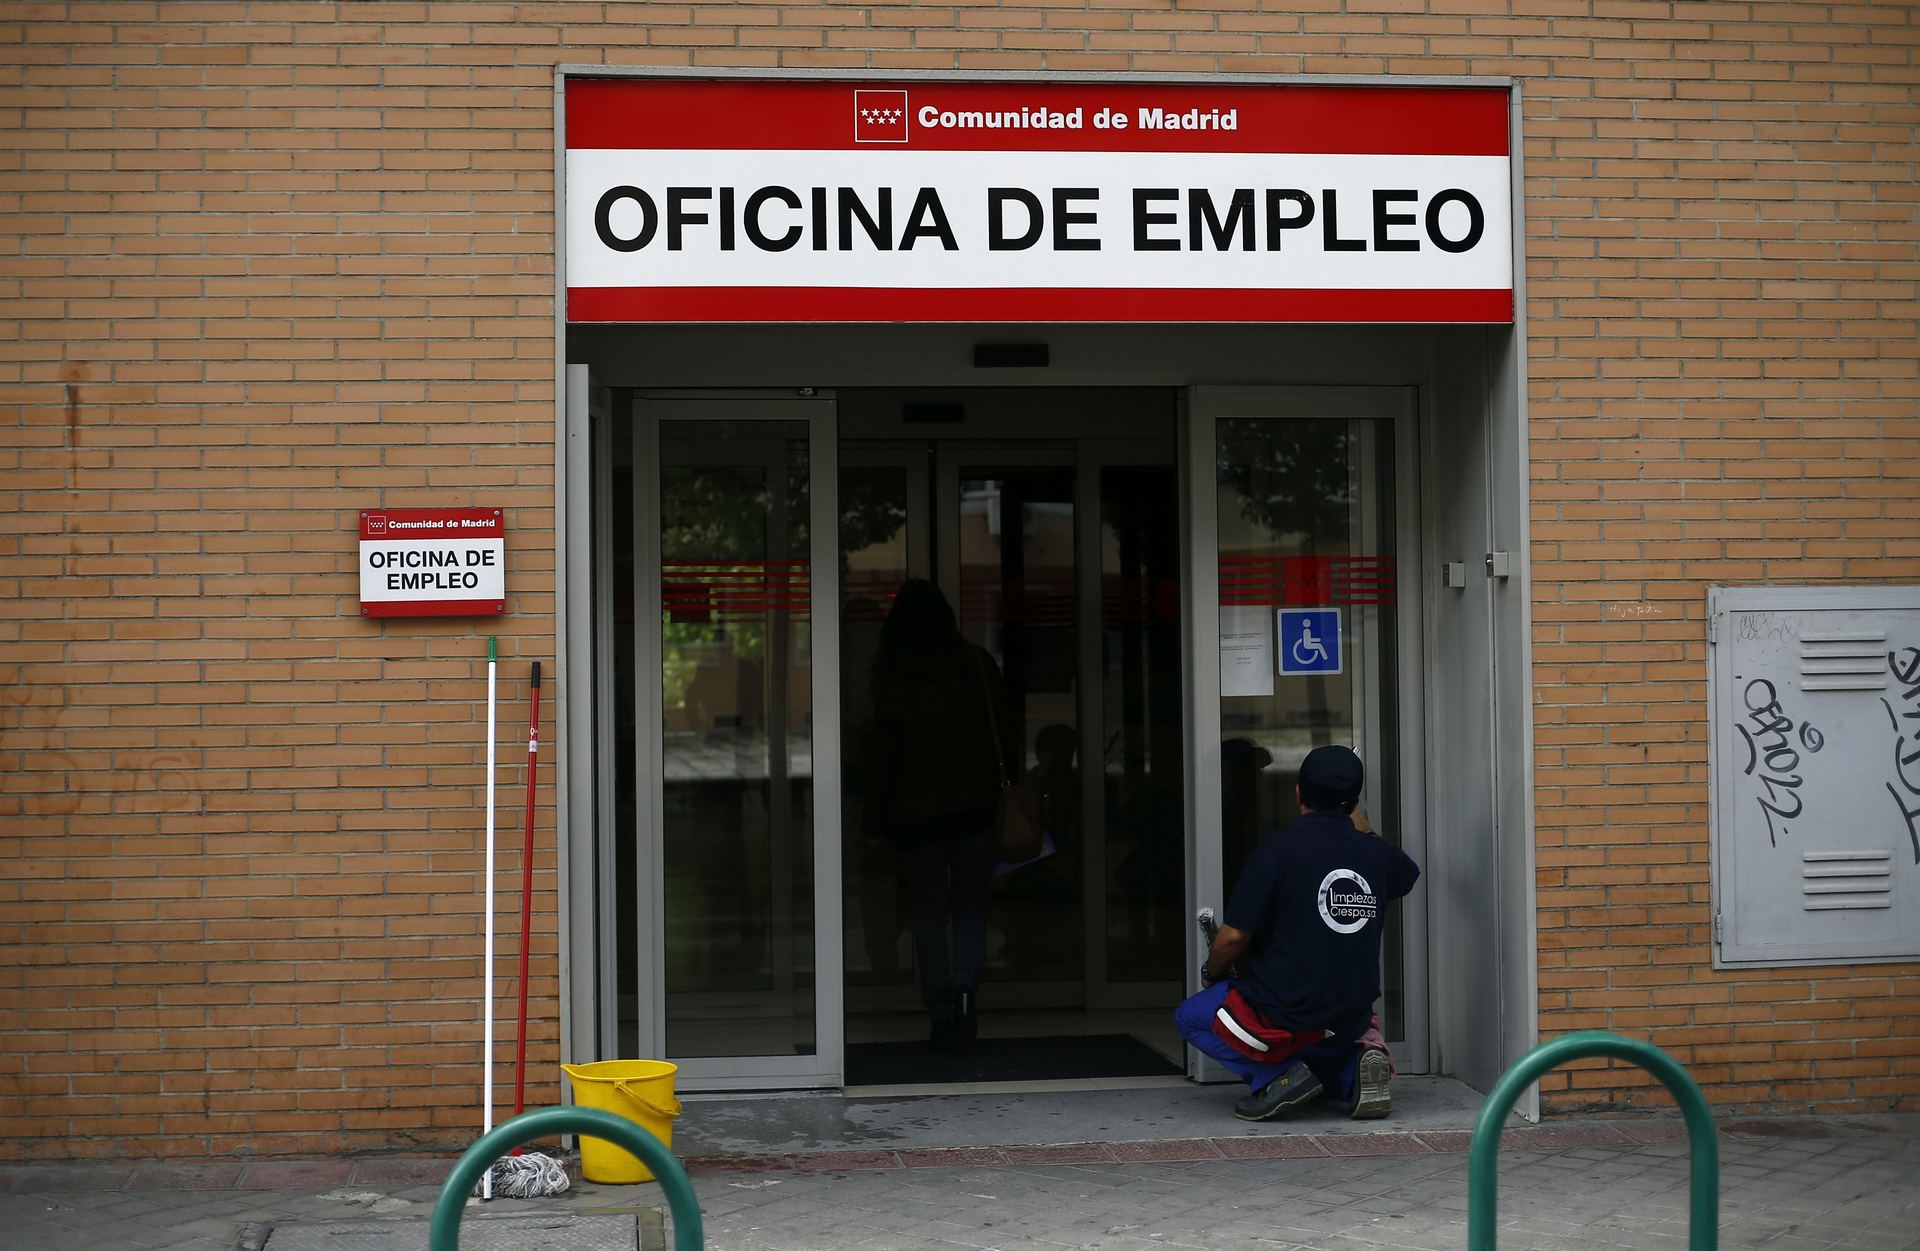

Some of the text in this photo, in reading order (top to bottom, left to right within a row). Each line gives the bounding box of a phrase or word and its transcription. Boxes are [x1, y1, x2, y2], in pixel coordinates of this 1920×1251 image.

[918, 105, 1238, 131] Comunidad de Madrid
[594, 185, 1485, 254] OFICINA DE EMPLEO
[388, 518, 496, 529] Comunidad de Madrid
[369, 549, 496, 569] OFICINA DE
[387, 571, 479, 590] EMPLEO
[1329, 887, 1377, 906] Limpiezas
